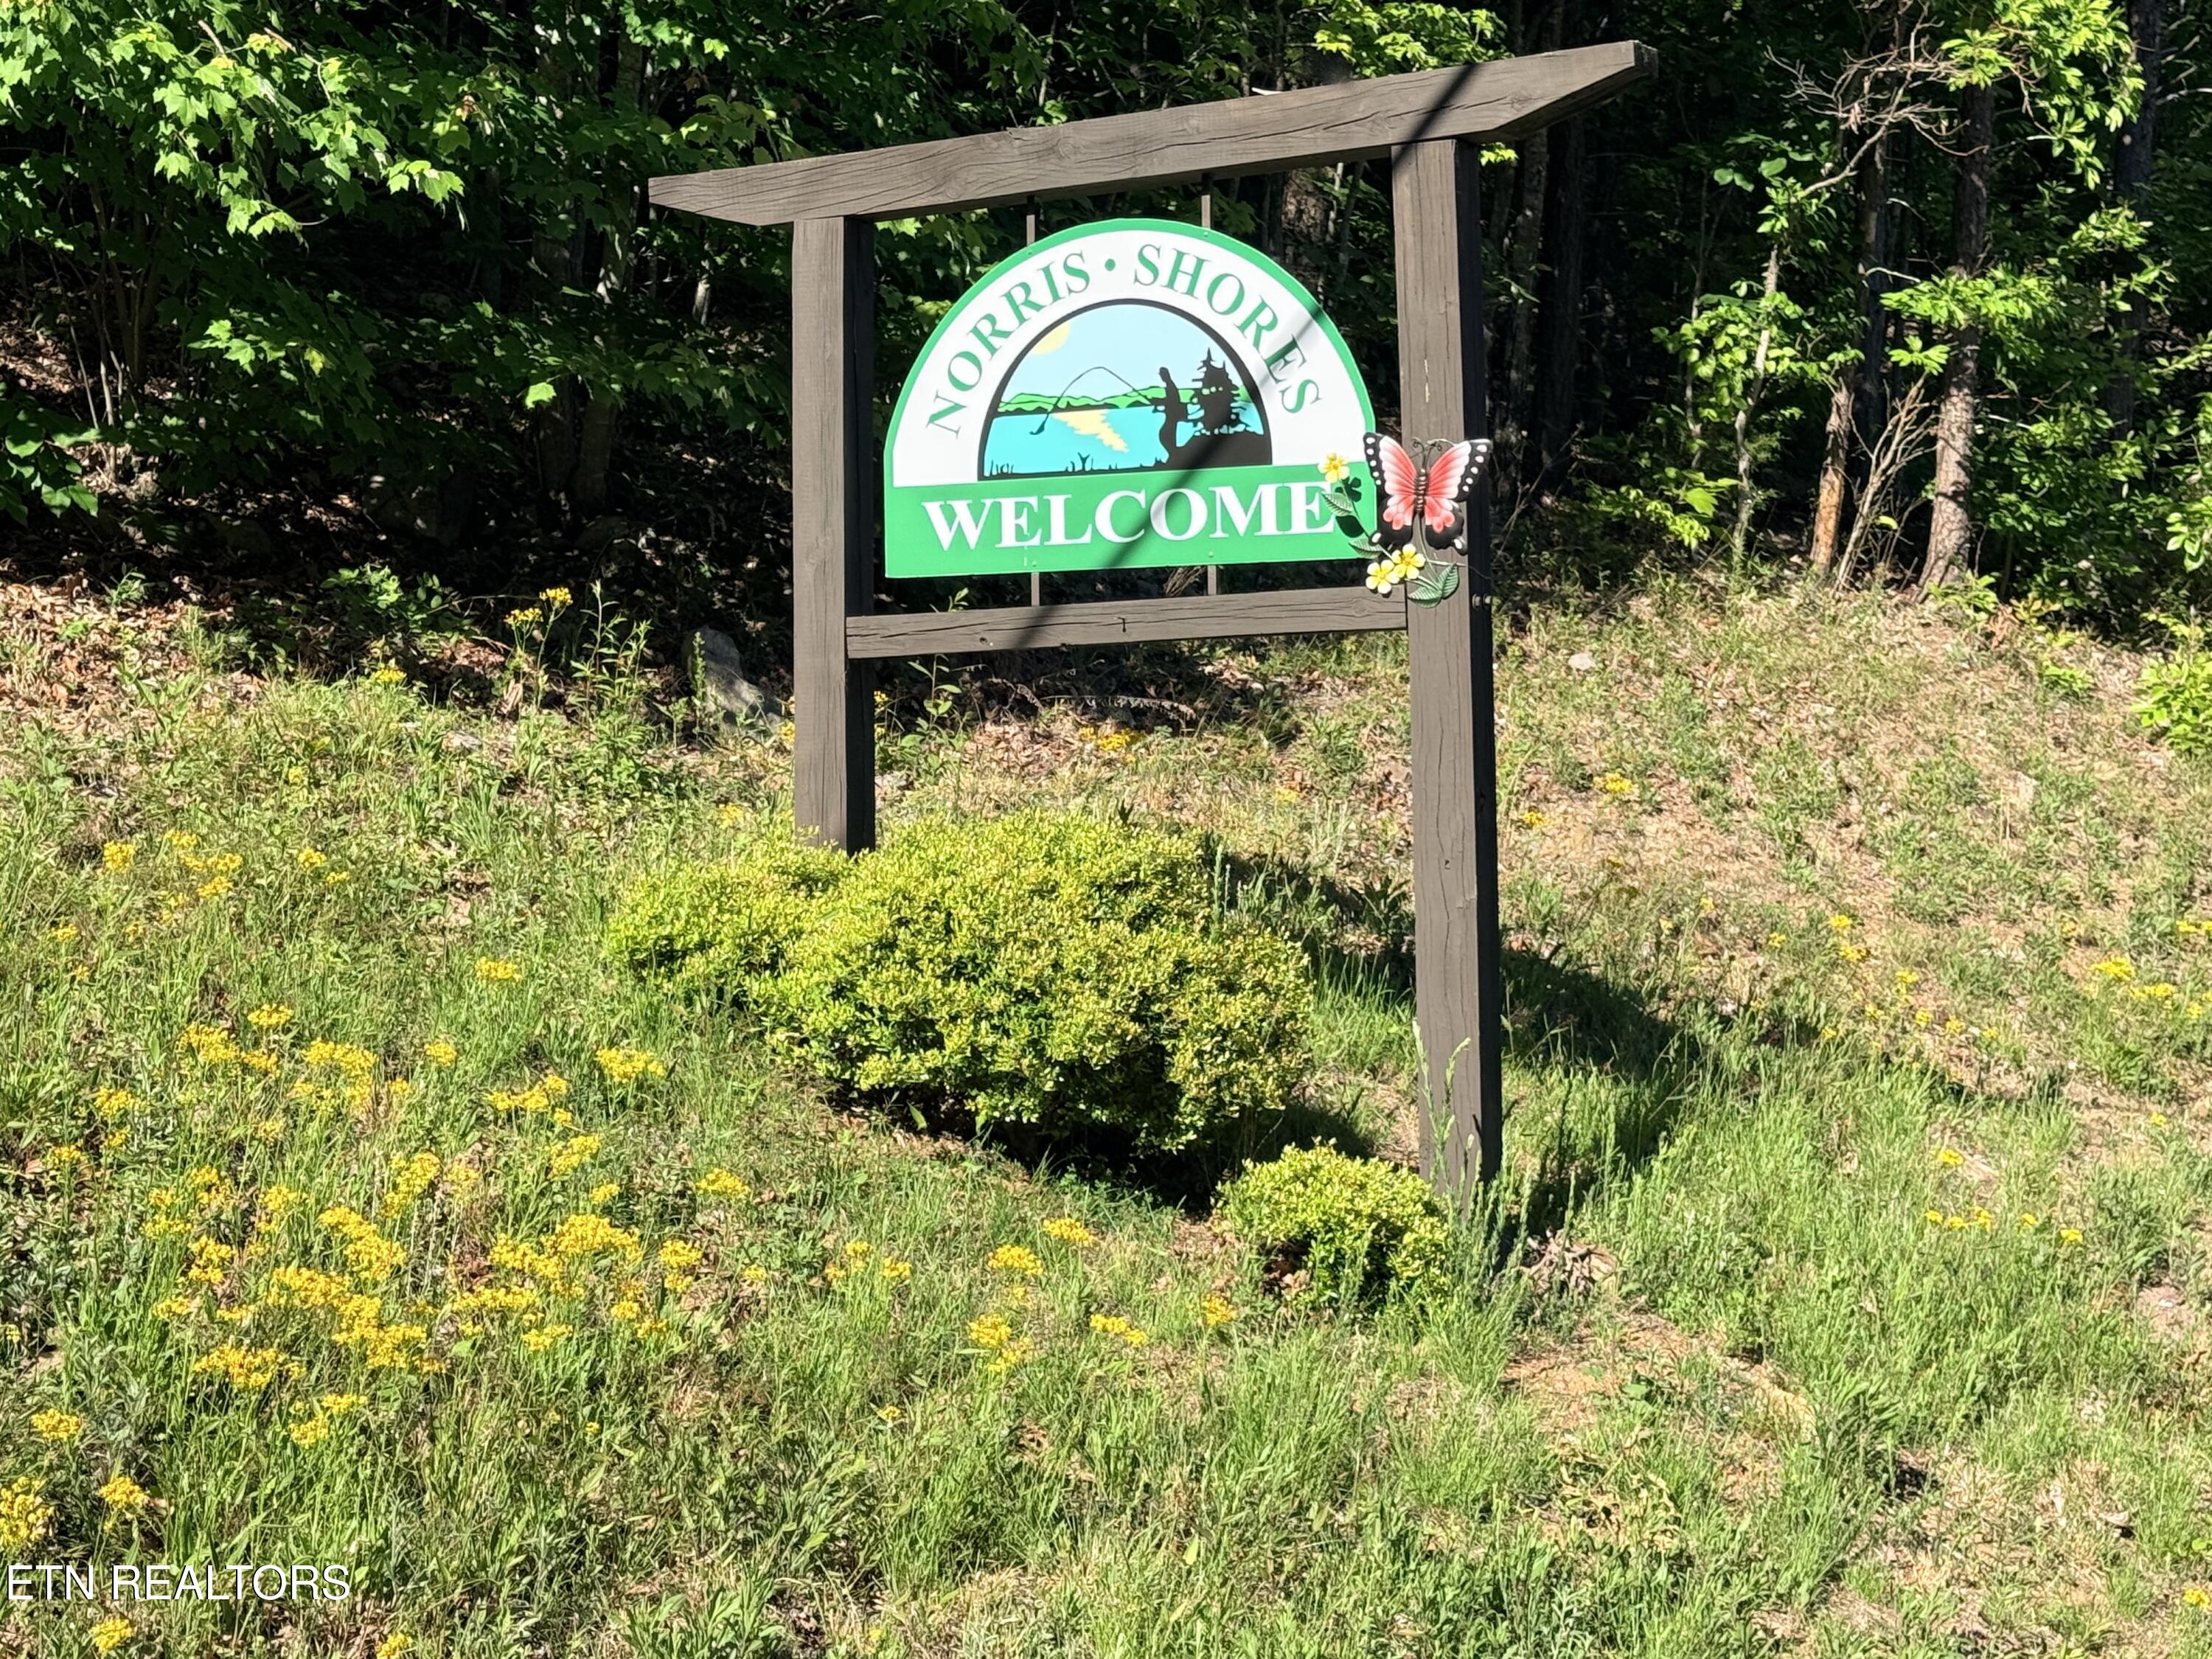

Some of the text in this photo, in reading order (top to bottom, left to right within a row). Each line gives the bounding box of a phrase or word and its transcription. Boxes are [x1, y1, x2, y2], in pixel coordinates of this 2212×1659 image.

[927, 243, 1322, 439] NORRIS SHORES
[921, 480, 1335, 552] WELCOME
